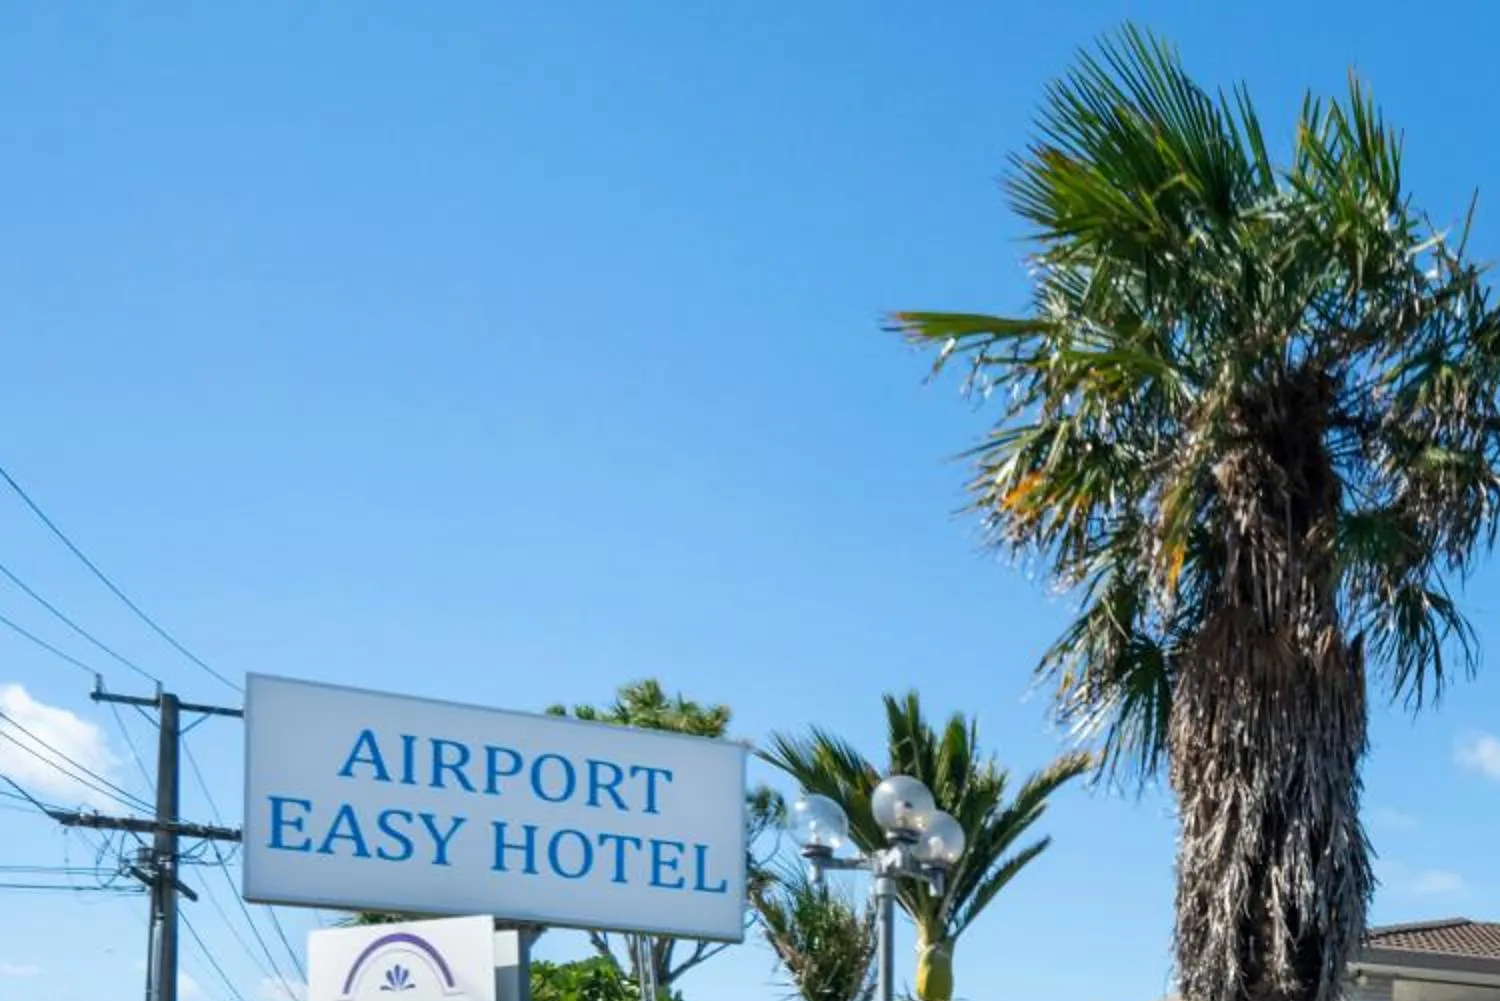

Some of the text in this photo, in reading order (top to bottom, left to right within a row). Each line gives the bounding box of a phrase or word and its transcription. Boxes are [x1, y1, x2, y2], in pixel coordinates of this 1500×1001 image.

[337, 728, 673, 815] AIRPORT
[266, 795, 728, 894] EASY HOTEL
